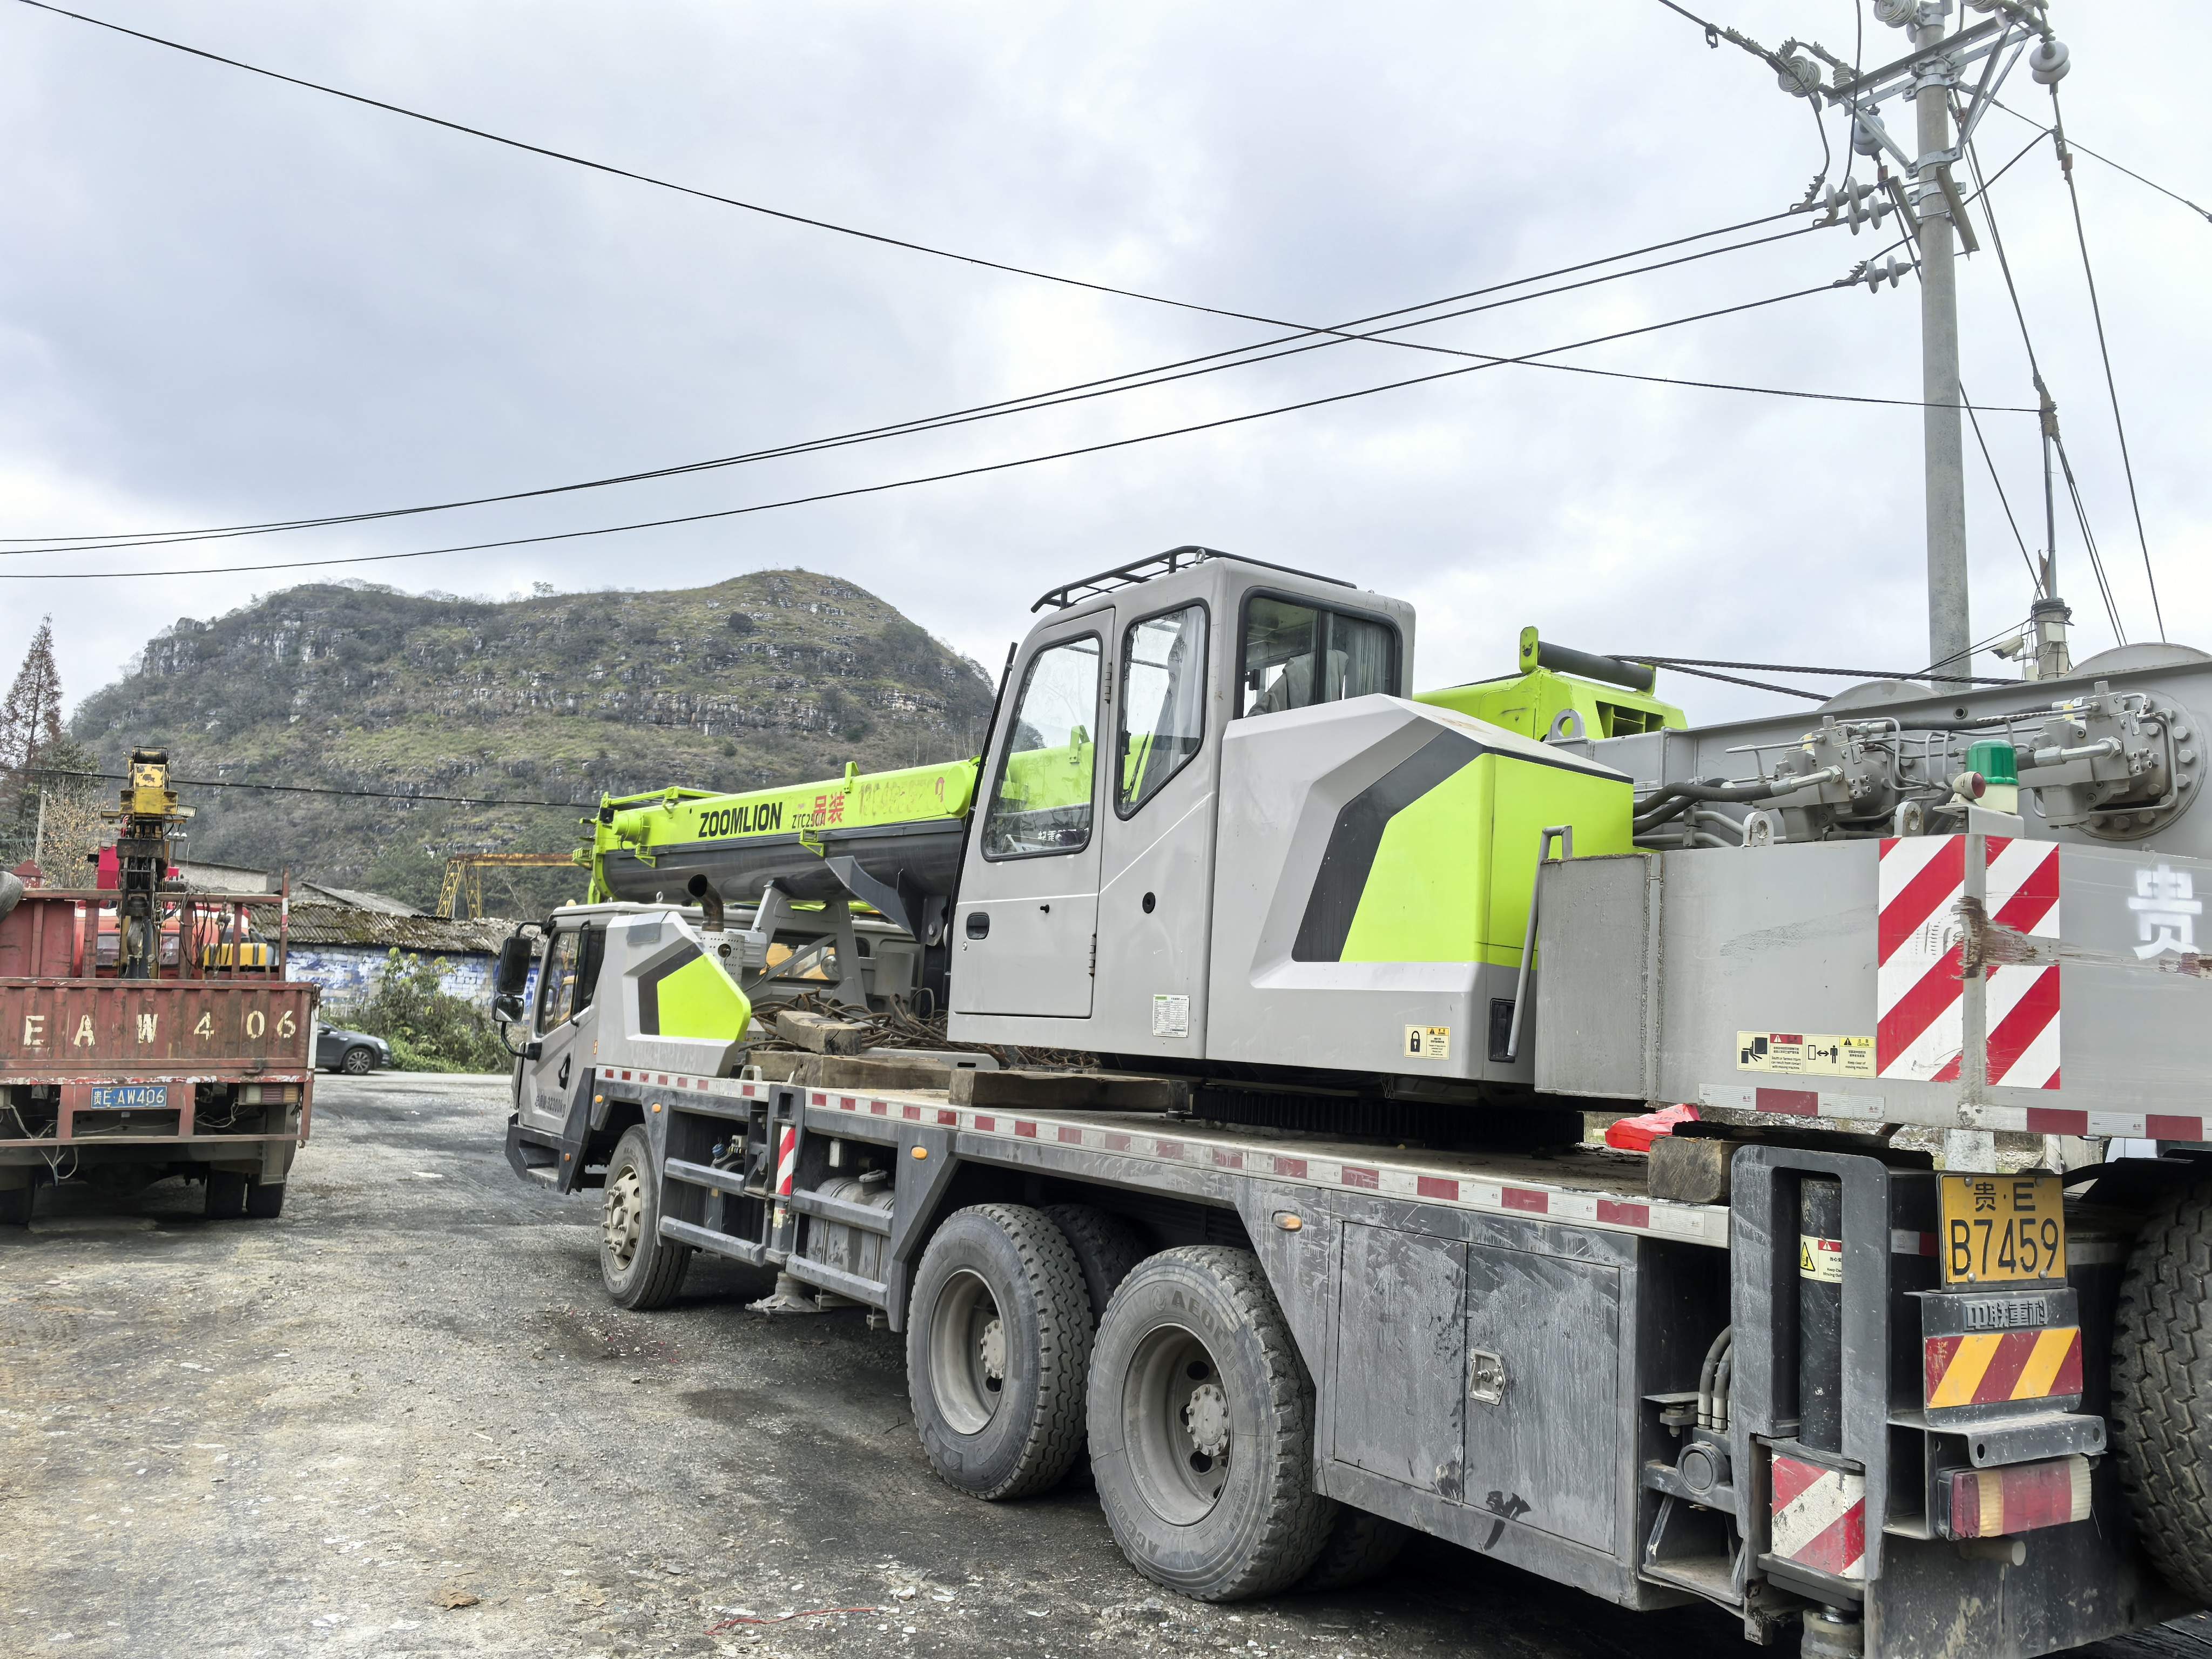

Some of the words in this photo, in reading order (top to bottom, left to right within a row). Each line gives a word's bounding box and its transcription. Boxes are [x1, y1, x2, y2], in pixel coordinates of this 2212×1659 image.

[698, 801, 783, 838] ZOOMLION
[813, 791, 846, 824] 吊装
[2127, 862, 2203, 961] 贵
[93, 1089, 165, 1105] 贵E·AW406
[1950, 1218, 2059, 1276] B7459
[1966, 1297, 2048, 1330] 中联重科
